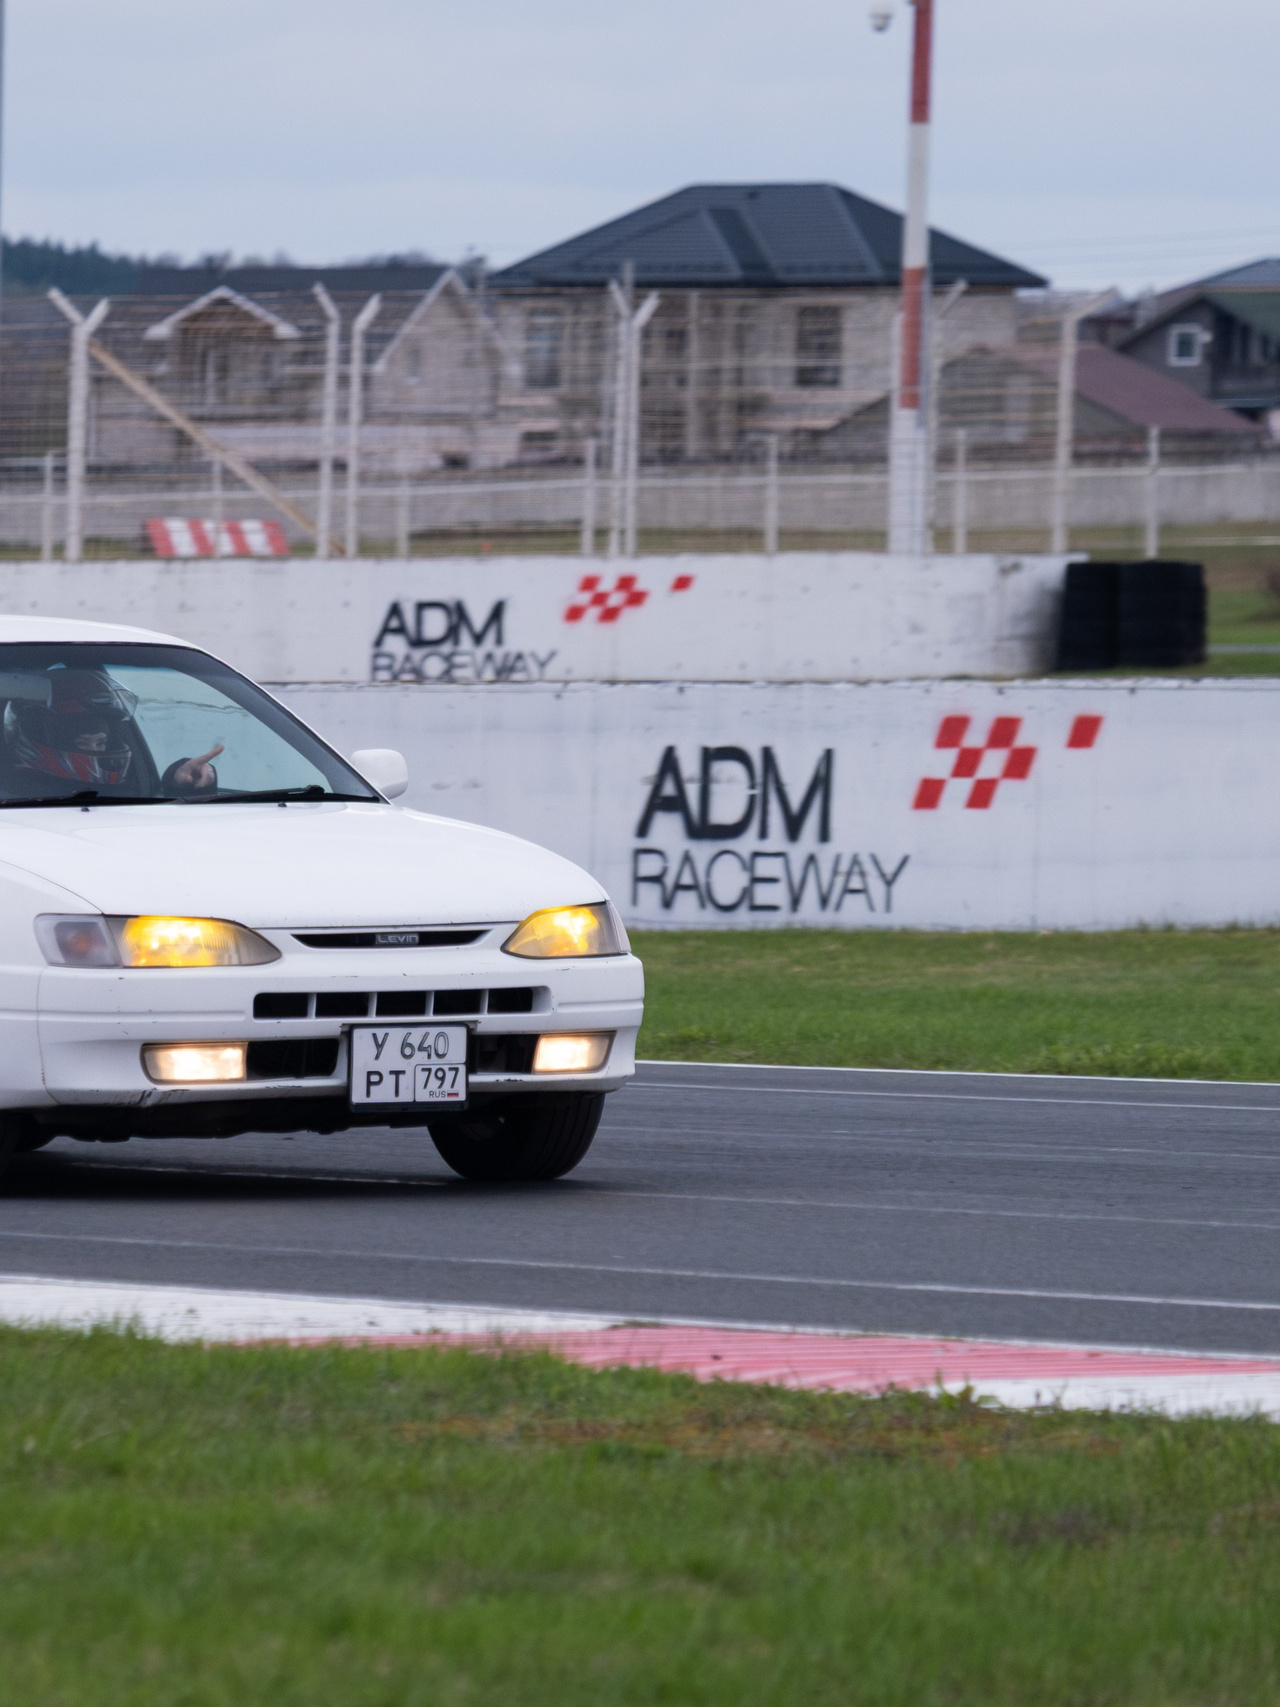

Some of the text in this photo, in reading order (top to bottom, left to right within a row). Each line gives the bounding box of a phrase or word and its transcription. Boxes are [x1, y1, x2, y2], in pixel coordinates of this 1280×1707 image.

[373, 600, 508, 648] ADM
[371, 650, 559, 681] RACEWAY
[635, 745, 834, 843] ADM
[631, 848, 910, 913] RACEWAY
[377, 934, 419, 944] LEVIN
[400, 1031, 449, 1060] 640
[421, 1067, 460, 1089] 797
[429, 1090, 447, 1098] RUS
